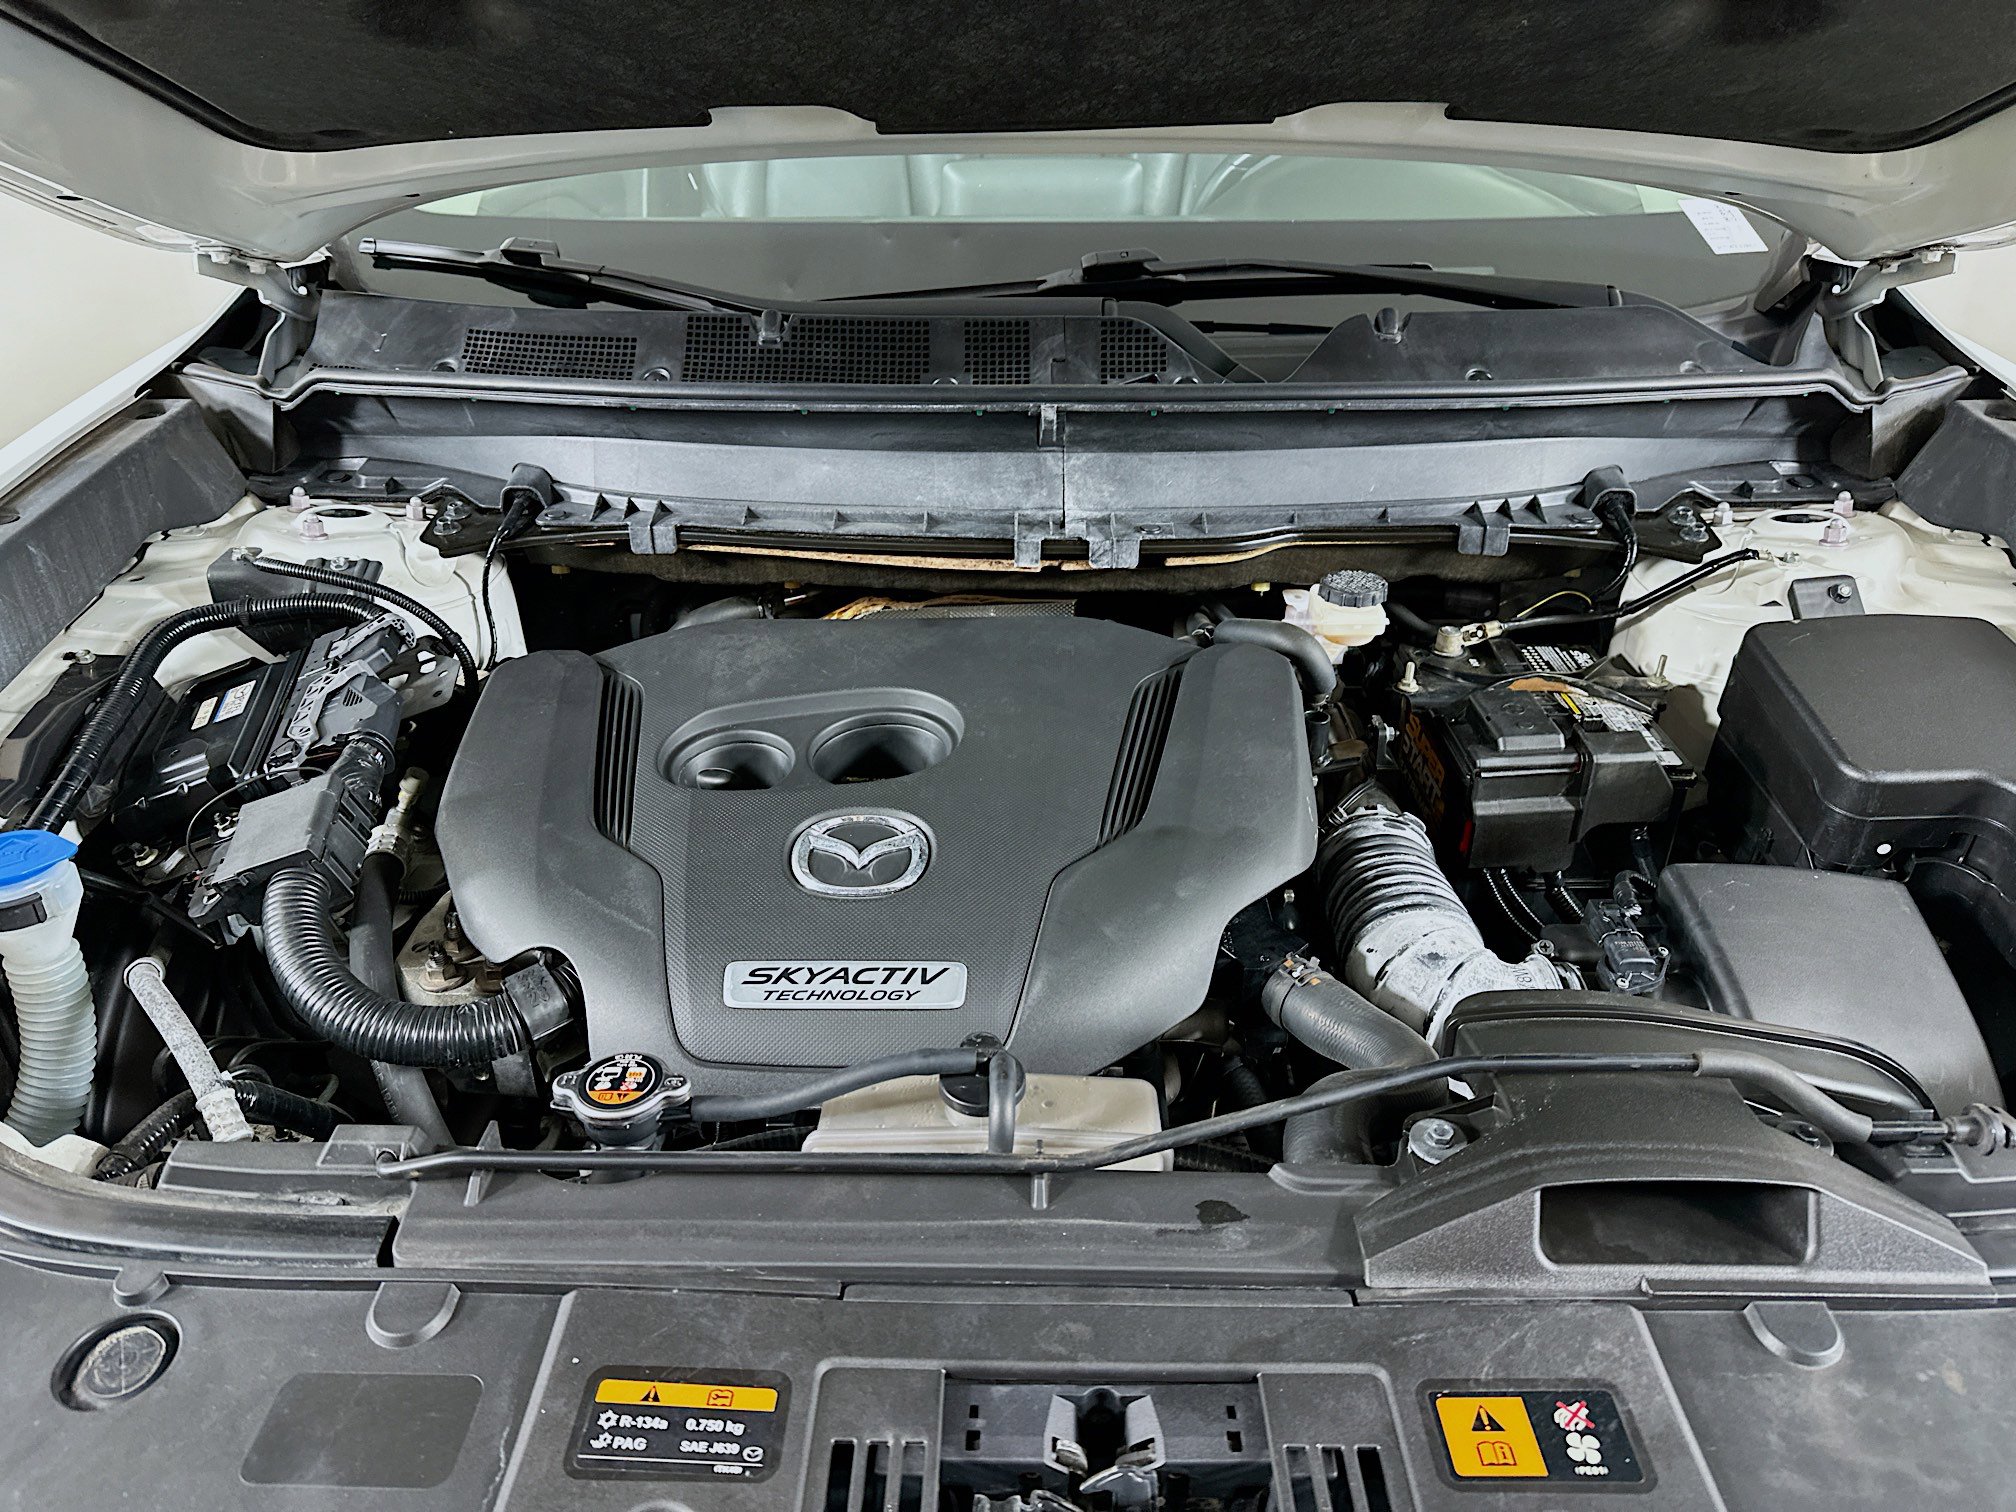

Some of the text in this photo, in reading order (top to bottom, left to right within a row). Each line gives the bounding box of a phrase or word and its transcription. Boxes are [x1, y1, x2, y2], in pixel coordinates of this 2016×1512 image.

[741, 967, 950, 985] SKYACTIV
[763, 990, 921, 1001] TECHNOLOGY
[618, 1414, 746, 1436] R-134a 0.750 kg
[611, 1435, 648, 1451] PAG
[679, 1440, 710, 1453] SAE
